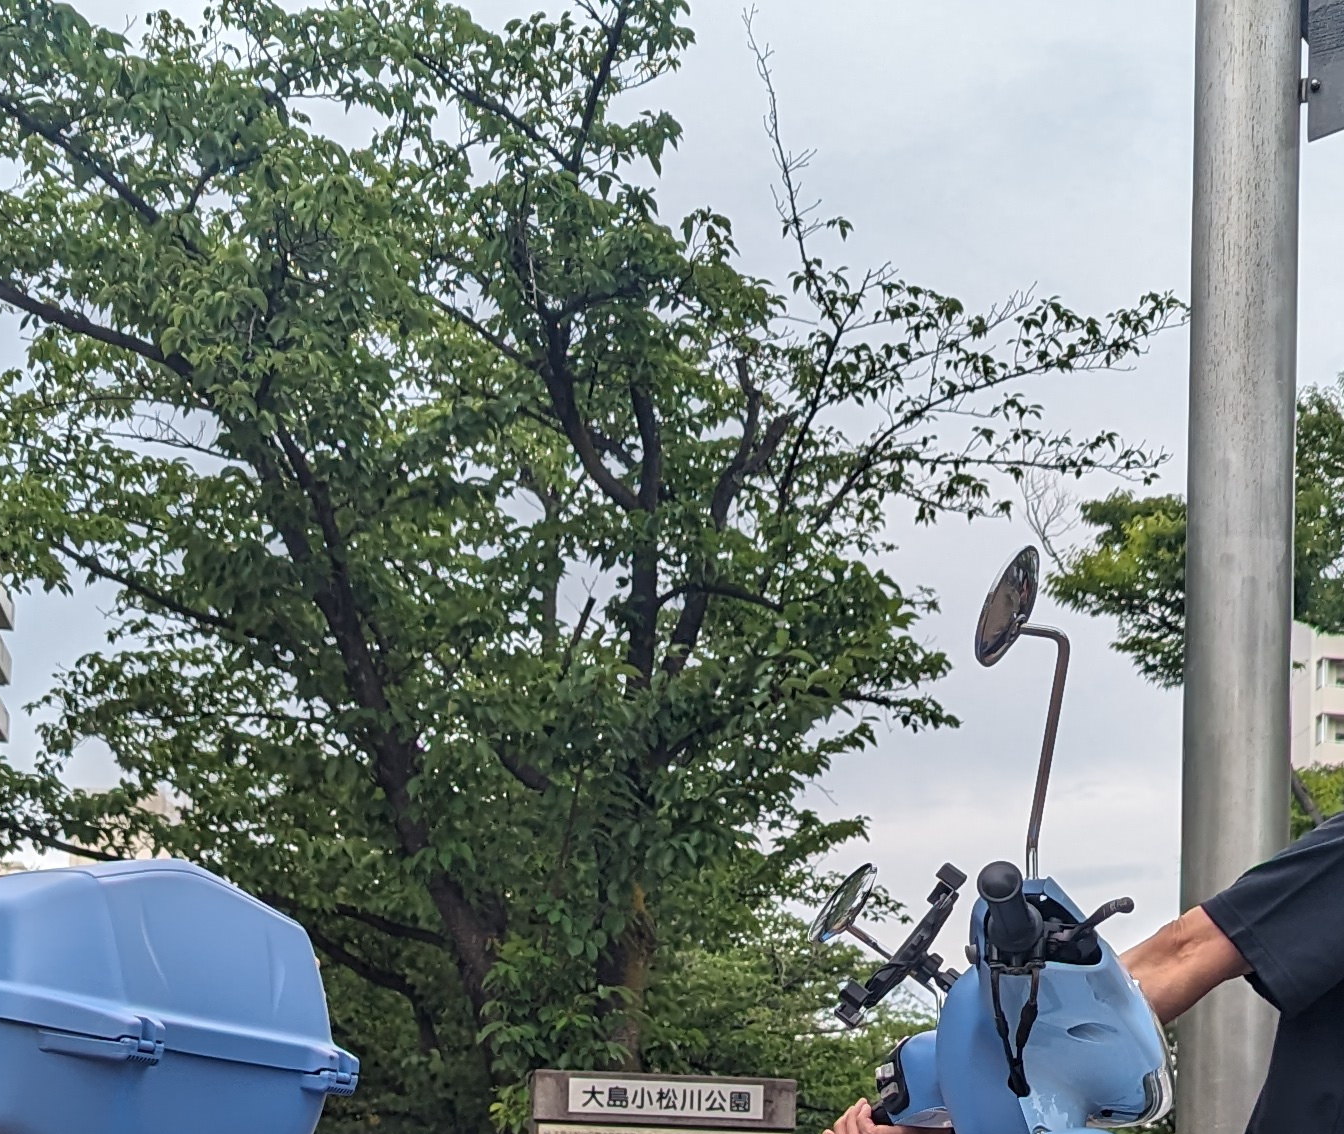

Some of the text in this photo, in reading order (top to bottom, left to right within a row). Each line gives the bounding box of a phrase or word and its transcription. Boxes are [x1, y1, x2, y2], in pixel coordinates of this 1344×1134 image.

[581, 1085, 751, 1113] 大島小松川公園
